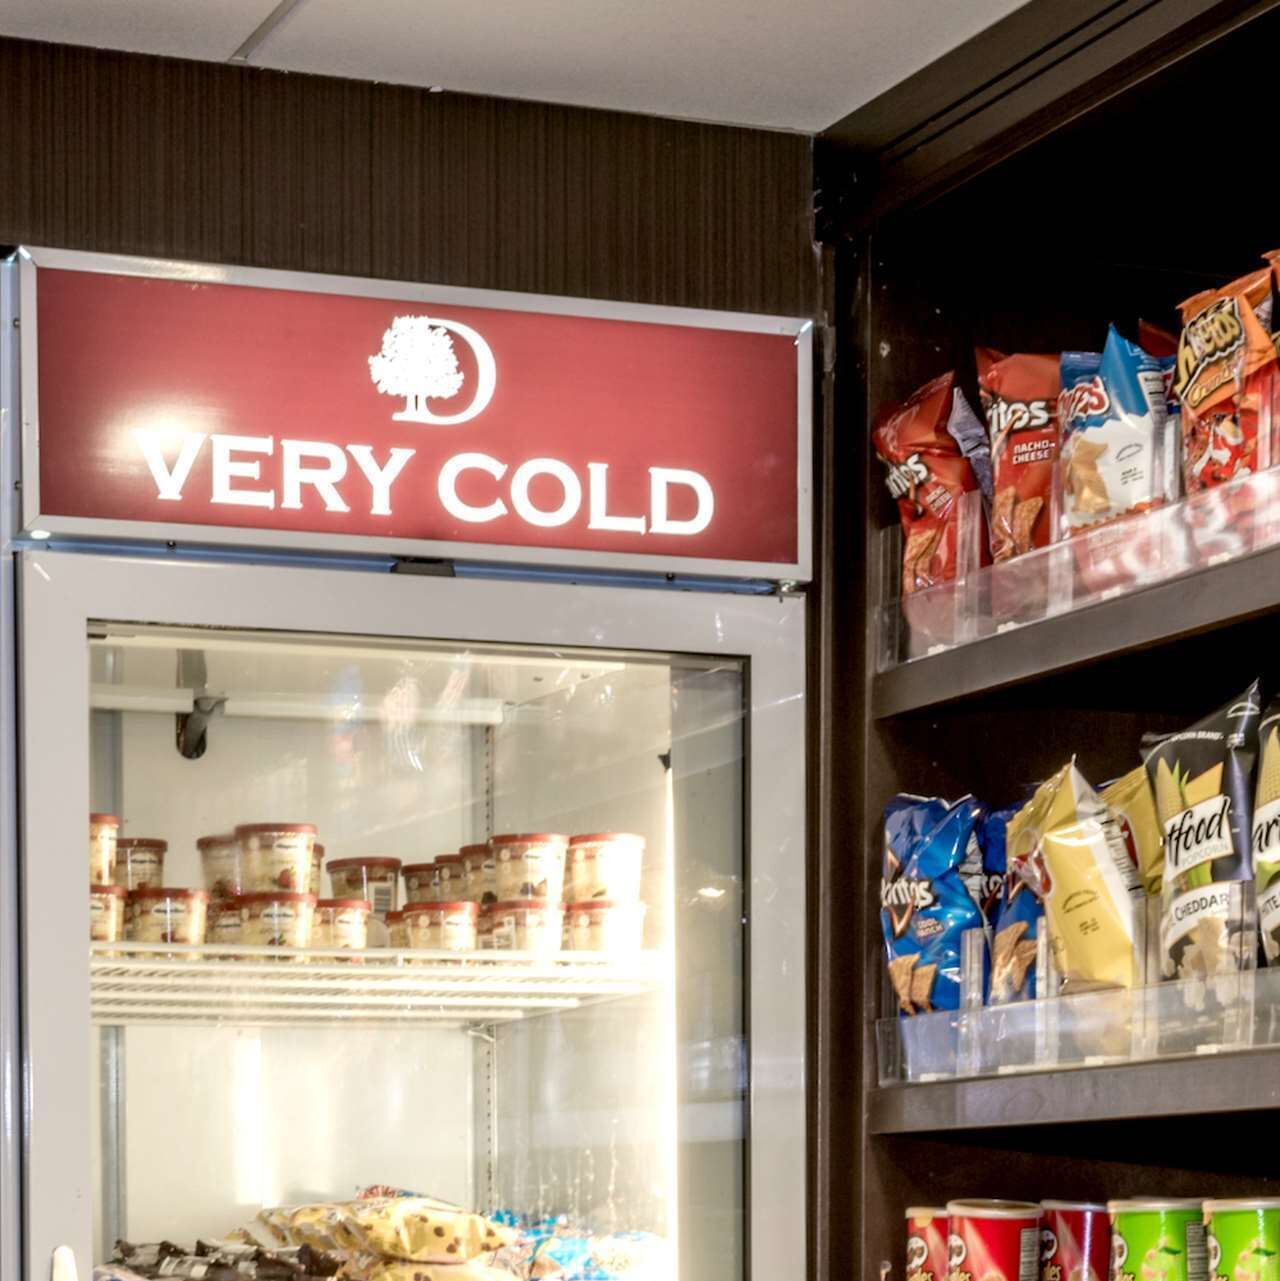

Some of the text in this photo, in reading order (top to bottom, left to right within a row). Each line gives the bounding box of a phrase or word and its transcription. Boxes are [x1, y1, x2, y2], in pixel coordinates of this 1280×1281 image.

[1013, 440, 1049, 454] NACHO
[1012, 450, 1050, 465] CHEESE
[133, 428, 714, 536] VERY COLD
